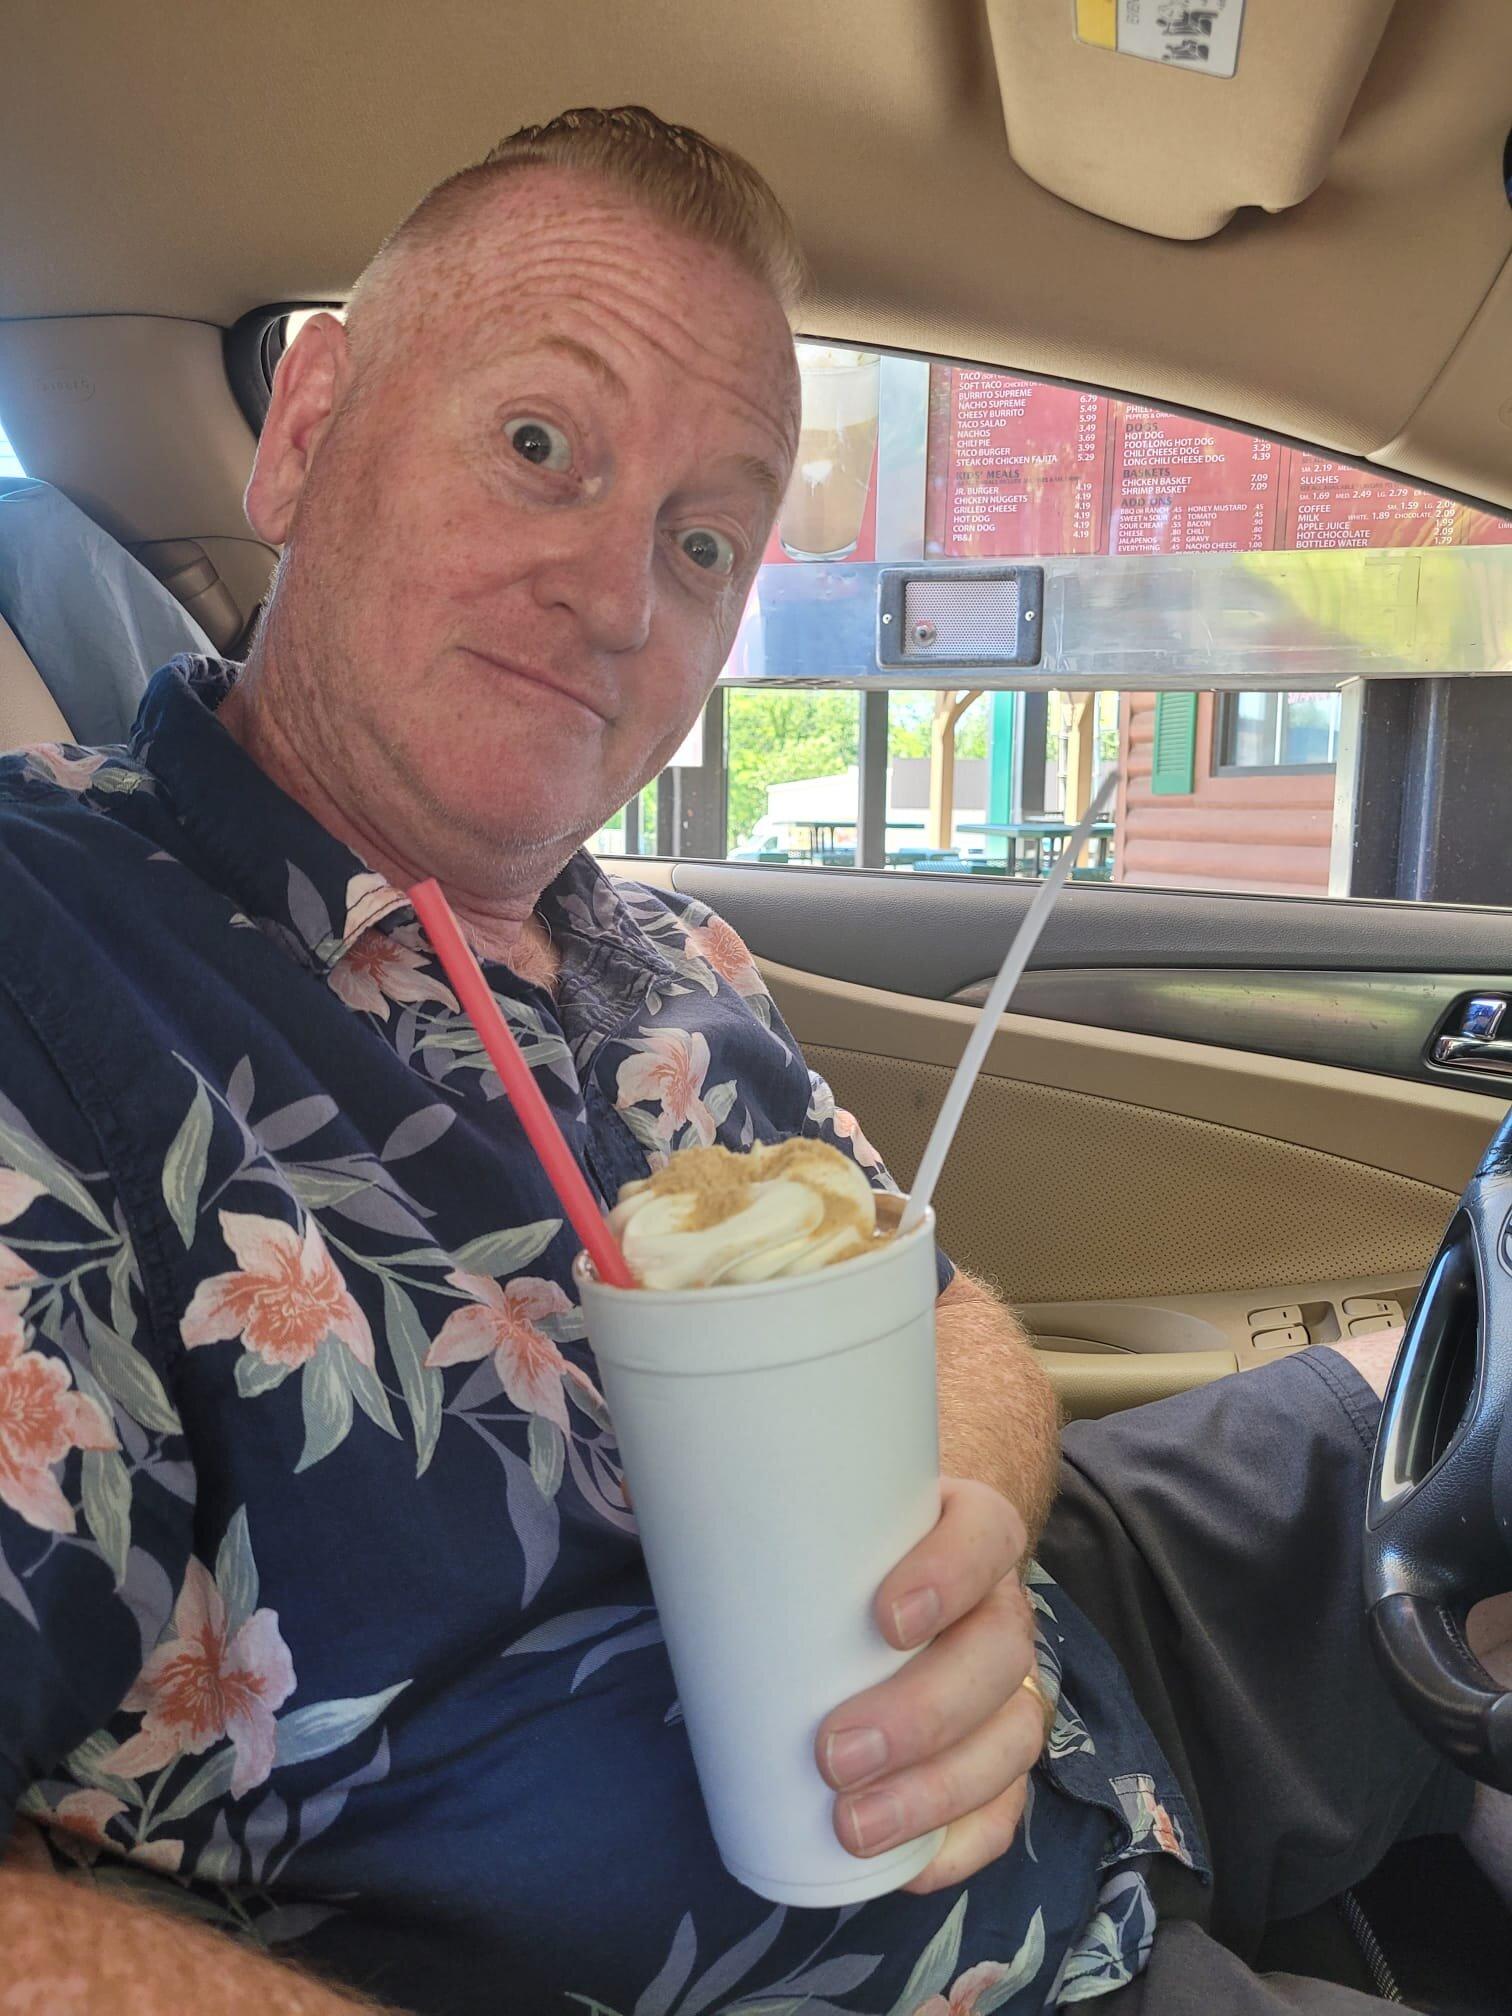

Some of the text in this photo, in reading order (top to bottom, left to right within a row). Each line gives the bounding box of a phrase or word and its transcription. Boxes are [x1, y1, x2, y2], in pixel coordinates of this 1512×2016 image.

[960, 372, 980, 380] TACO
[960, 382, 980, 390] SOFT
[982, 381, 1002, 389] TACO
[959, 389, 1032, 400] BURRITO SUPREME
[959, 401, 987, 409] NACHO
[988, 399, 1026, 408] SUPREME
[958, 405, 1097, 419] CHEESY BURRITO 5.49
[958, 414, 1096, 429] TACO SALAD 5.99
[957, 424, 1096, 438] NACHOS 3.49
[1126, 423, 1158, 432] DOGS
[957, 434, 1096, 448] CHILI PIE 3.69
[1125, 431, 1164, 440] HOT DOG
[1124, 437, 1214, 449] FOOT LONG HOT DOG
[957, 444, 1095, 457] TACO BURGER 3.99
[1124, 443, 1271, 457] CHILI CHEESE DOG 3.29
[956, 453, 1095, 467] STEAK OR CHICKEN FAJITA 5.29
[1123, 452, 1271, 466] LONG CHILI CHEESE DOG 4.39
[1123, 468, 1170, 478] BASKETS
[1314, 464, 1332, 472] 2.19
[986, 469, 1020, 479] MEALS
[1122, 474, 1268, 487] CHICKEN BASKET 7.09
[1300, 475, 1340, 485] SLUSHES
[954, 483, 1092, 495] JR. BURGER 4.19
[1121, 486, 1154, 496] SHRIMP
[1155, 485, 1187, 494] BASKET
[1313, 492, 1330, 500] 1.69
[1352, 490, 1372, 498] 2.49
[1389, 489, 1408, 497] 2.79
[954, 496, 989, 505] CHICKEN
[990, 495, 1028, 503] NUGGETS
[954, 502, 1090, 514] GRILLED CHEESE 4.19
[1298, 505, 1331, 513] COFFEE
[1401, 502, 1419, 510] 1.59
[953, 512, 1090, 523] HOT DOG 4.19
[1298, 513, 1320, 521] MILK
[1372, 511, 1390, 520] 1.89
[1436, 510, 1455, 518] 2.09
[953, 521, 1090, 533] CORN DOG 4.19
[1297, 519, 1454, 531] APPLE JUICE 1.99
[952, 534, 972, 542] PB&J
[1296, 528, 1454, 540] HOT CHOCOLATE 2.09
[1118, 544, 1160, 552] EVERYTHING
[1212, 541, 1237, 549] CHEESE
[1296, 540, 1336, 549] BOTTLED
[1337, 539, 1368, 547] WATER
